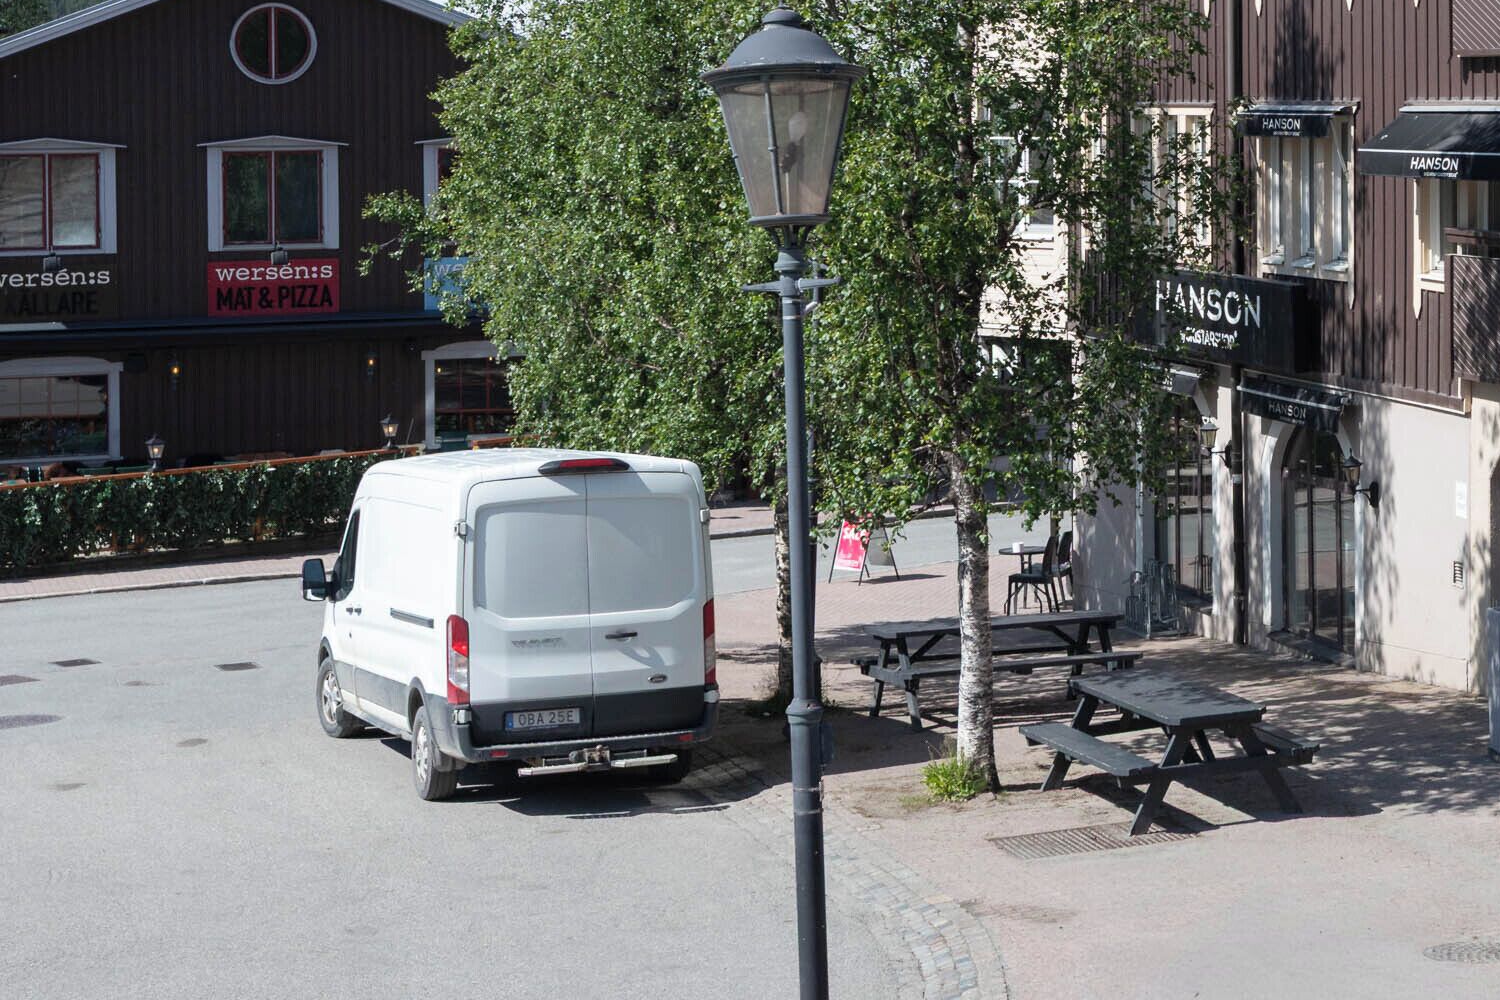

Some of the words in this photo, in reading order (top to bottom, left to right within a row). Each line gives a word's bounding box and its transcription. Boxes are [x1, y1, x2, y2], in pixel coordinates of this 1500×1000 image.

[1262, 118, 1301, 130] HANSON
[1410, 156, 1459, 171] HANSON
[216, 263, 333, 281] wersén:s
[216, 286, 255, 311] MAT
[258, 286, 273, 309] &
[277, 284, 333, 309] PIZZA
[1155, 279, 1261, 329] HANSON
[1268, 401, 1307, 419] HANSON
[518, 712, 545, 726] OBA
[549, 710, 574, 724] 25E
